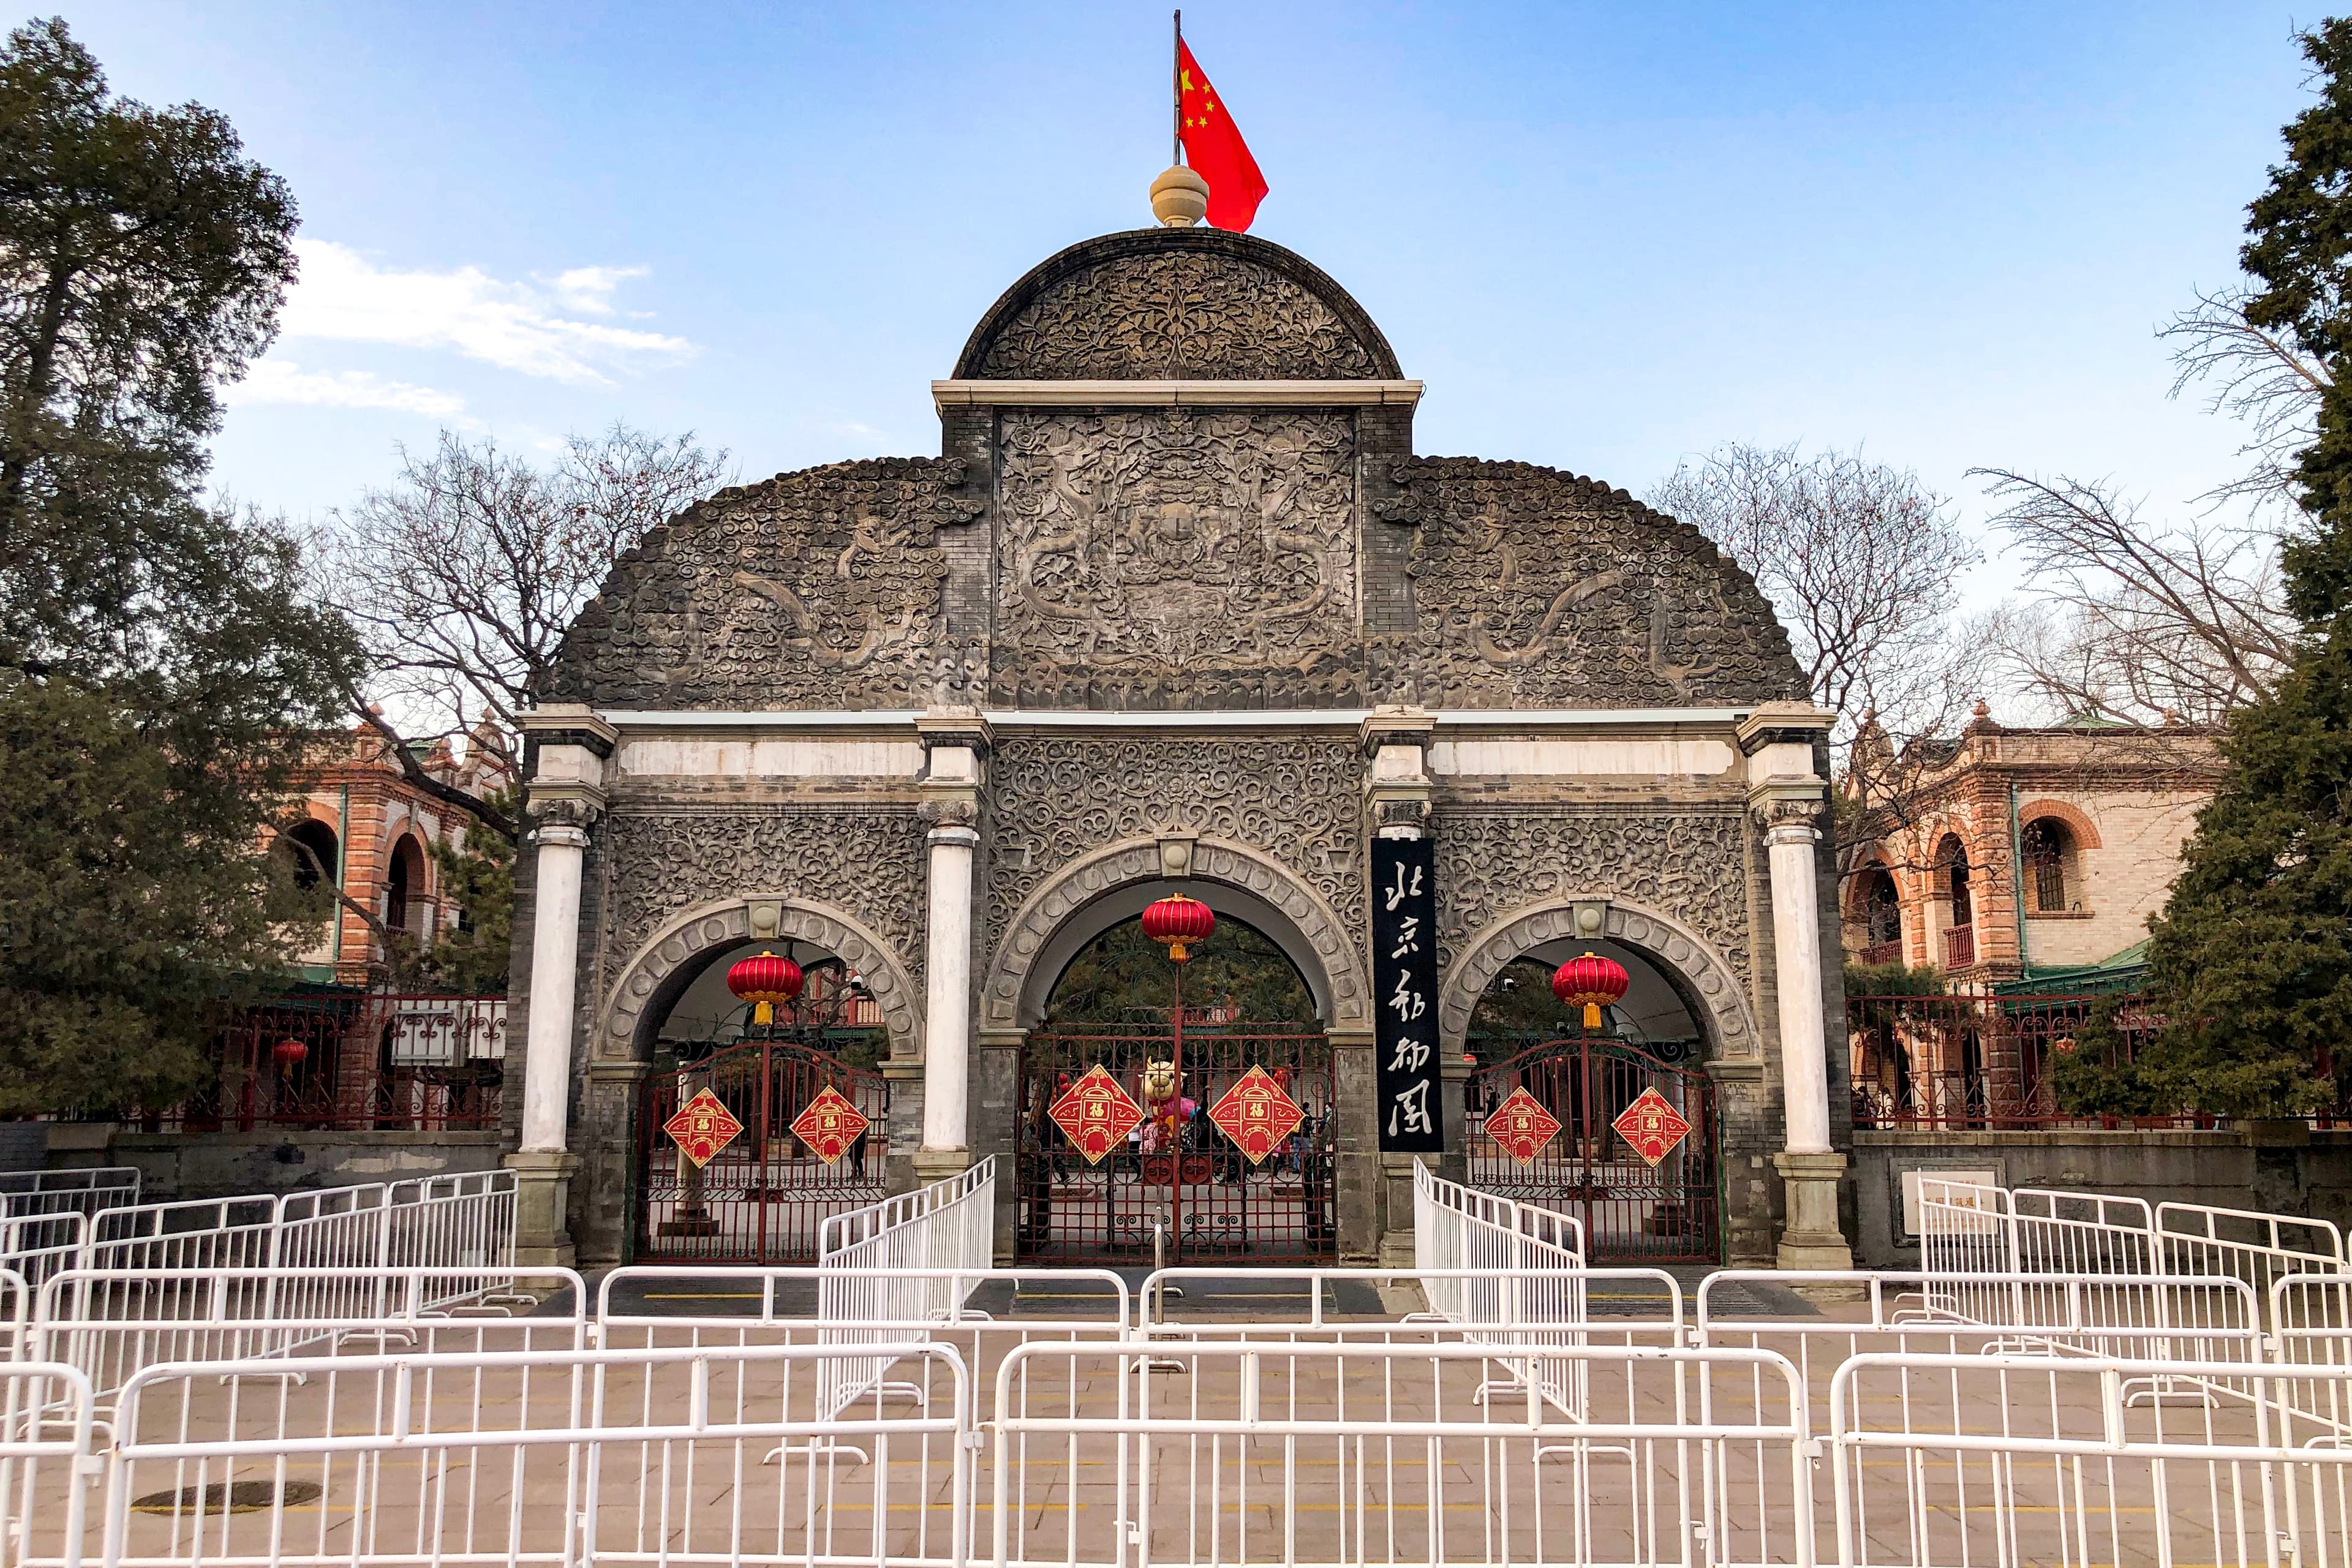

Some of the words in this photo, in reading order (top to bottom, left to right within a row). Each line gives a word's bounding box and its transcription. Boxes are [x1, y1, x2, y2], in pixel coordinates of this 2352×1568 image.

[1090, 1102, 1104, 1117] 福
[1250, 1102, 1264, 1117] 福
[697, 1118, 710, 1130] 福
[824, 1115, 837, 1128] 福
[1517, 1117, 1529, 1129] 福
[1646, 1117, 1659, 1129] 福
